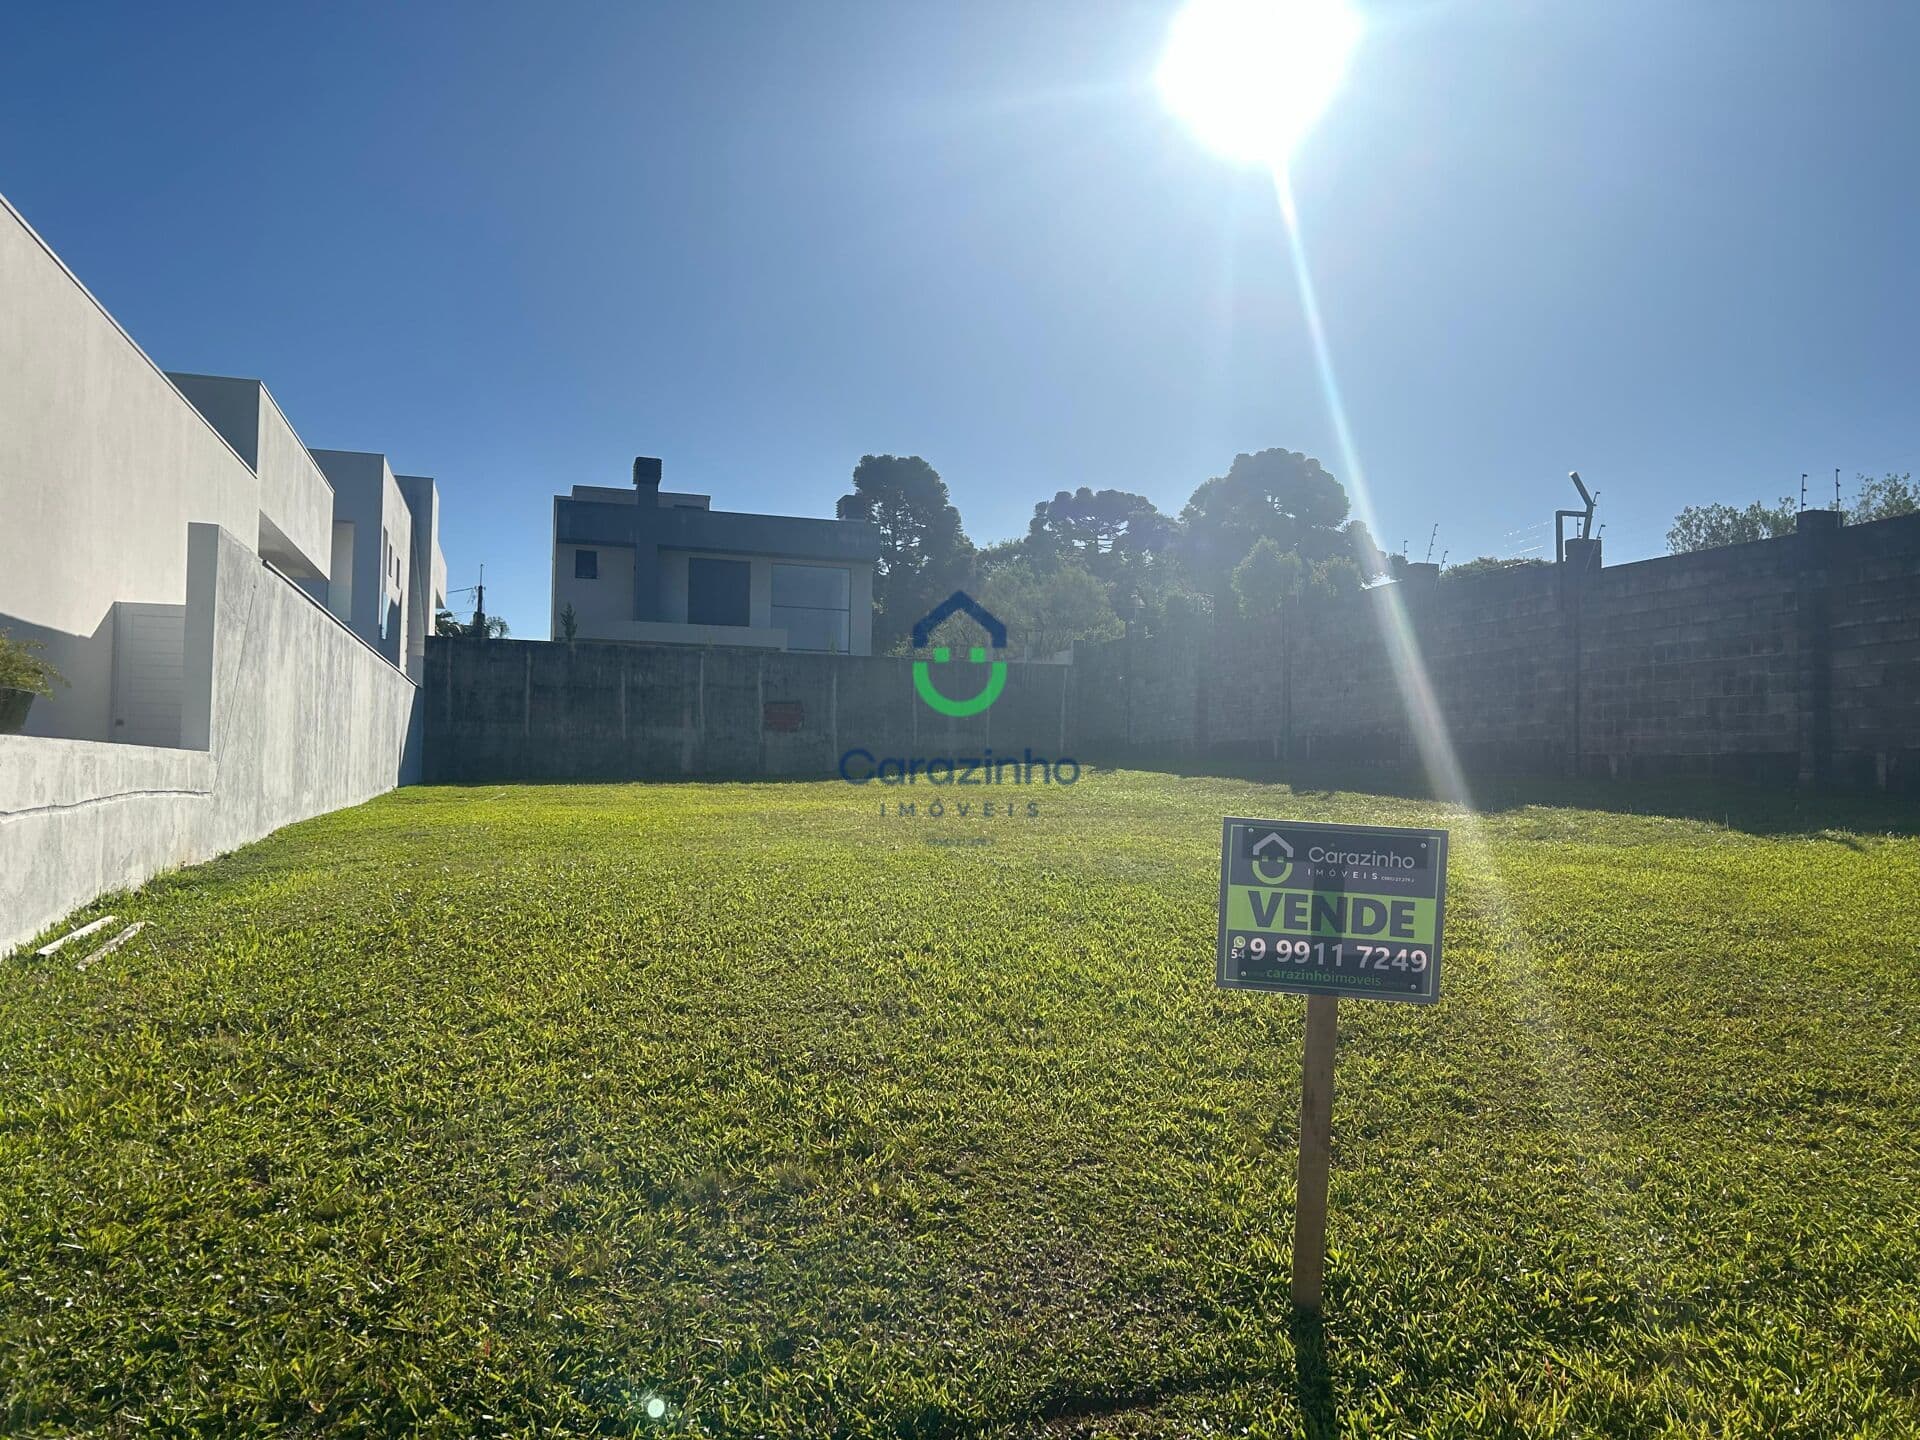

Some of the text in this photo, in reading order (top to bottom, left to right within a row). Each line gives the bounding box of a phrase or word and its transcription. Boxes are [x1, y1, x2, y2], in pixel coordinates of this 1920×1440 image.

[1308, 845, 1415, 869] Carazinho
[1307, 867, 1378, 880] IMÓVEIS
[1248, 890, 1416, 938] VENDE
[1231, 937, 1427, 972] 54 9 9911 7249
